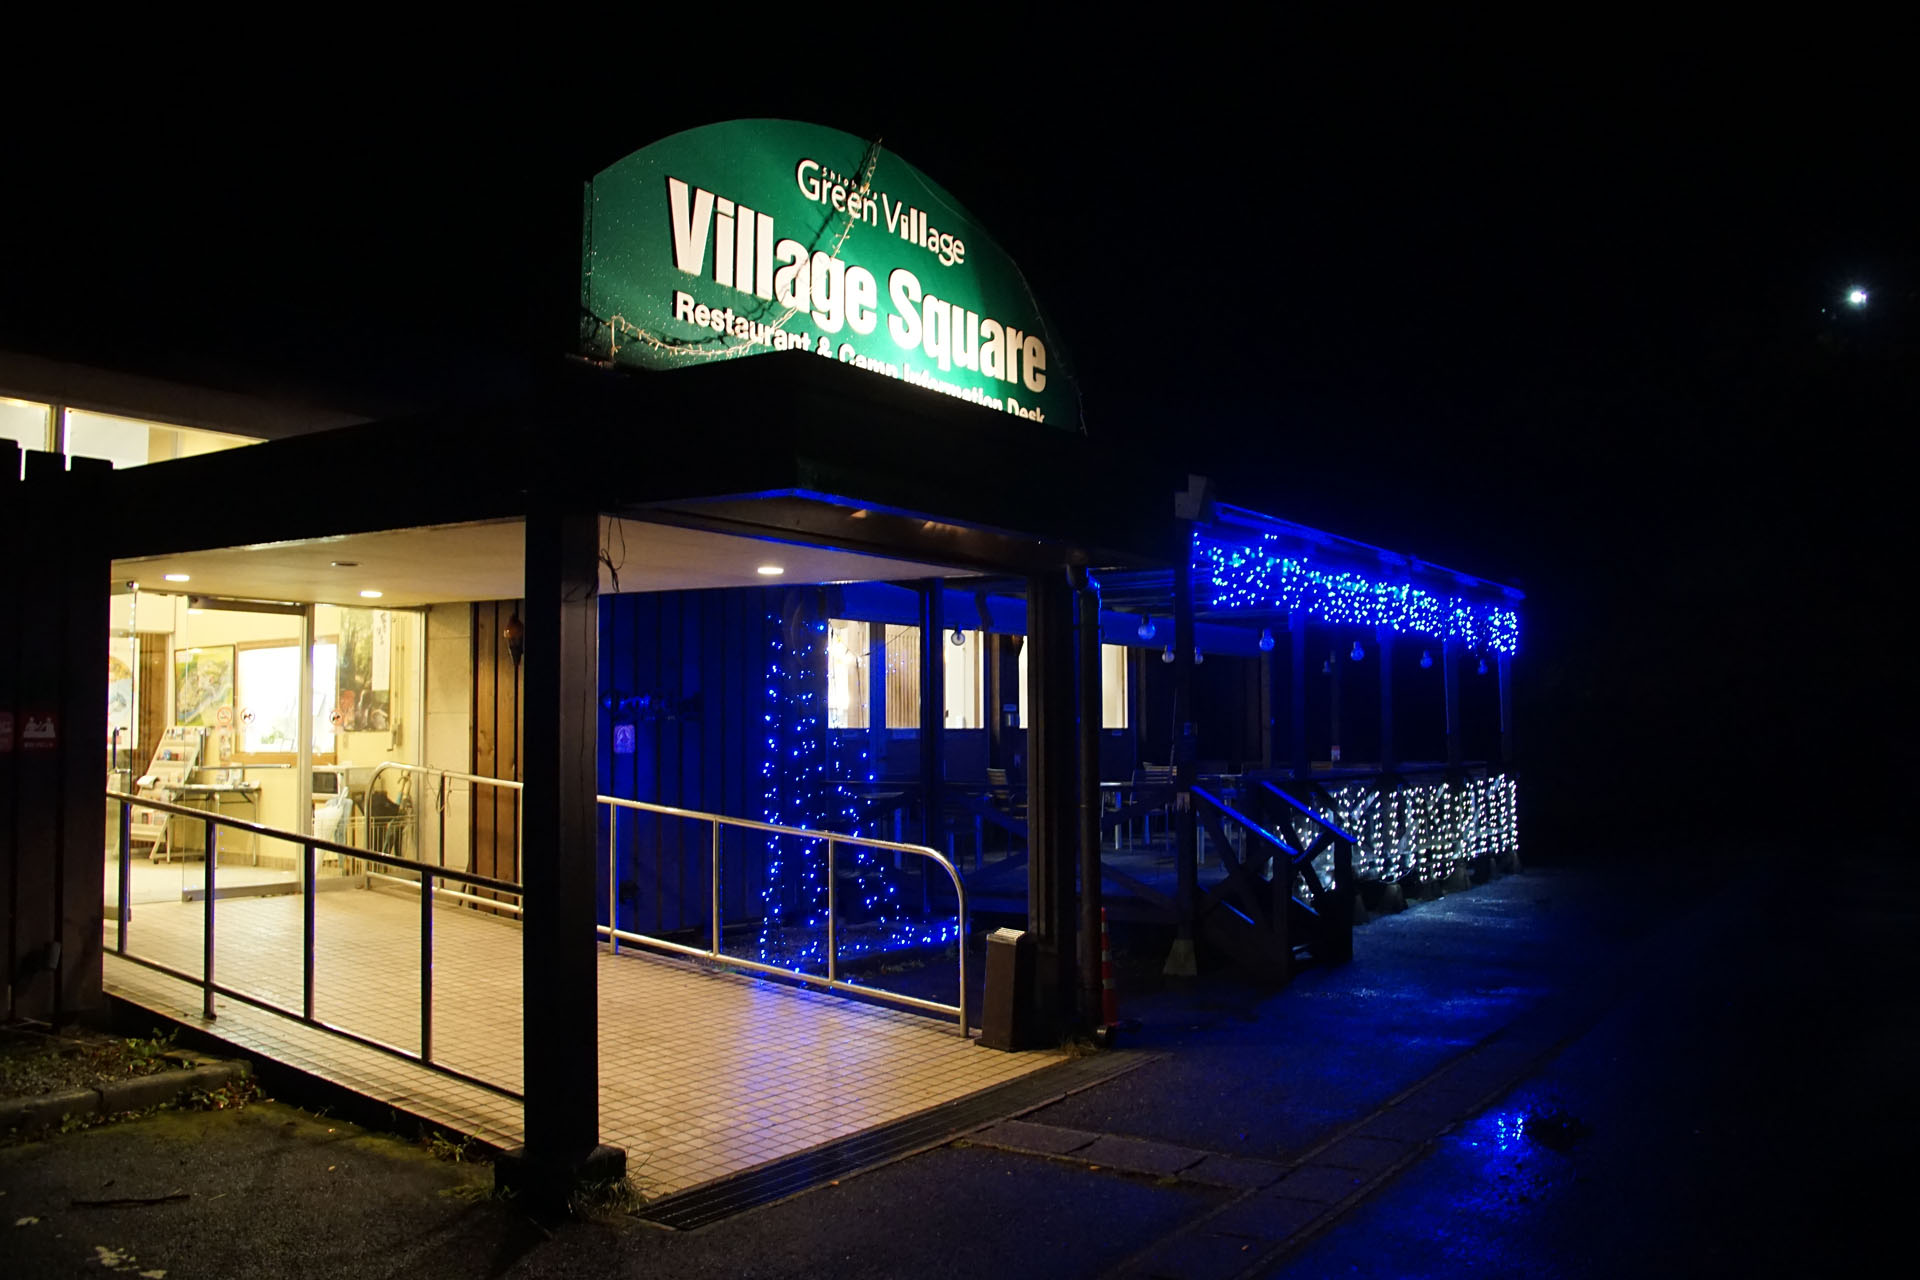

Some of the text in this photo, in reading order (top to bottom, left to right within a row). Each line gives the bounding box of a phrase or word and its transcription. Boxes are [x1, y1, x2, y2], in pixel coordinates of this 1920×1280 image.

[797, 159, 966, 267] Green Village
[669, 176, 1047, 393] Village Square
[676, 290, 812, 351] Restaurant
[816, 335, 833, 359] &
